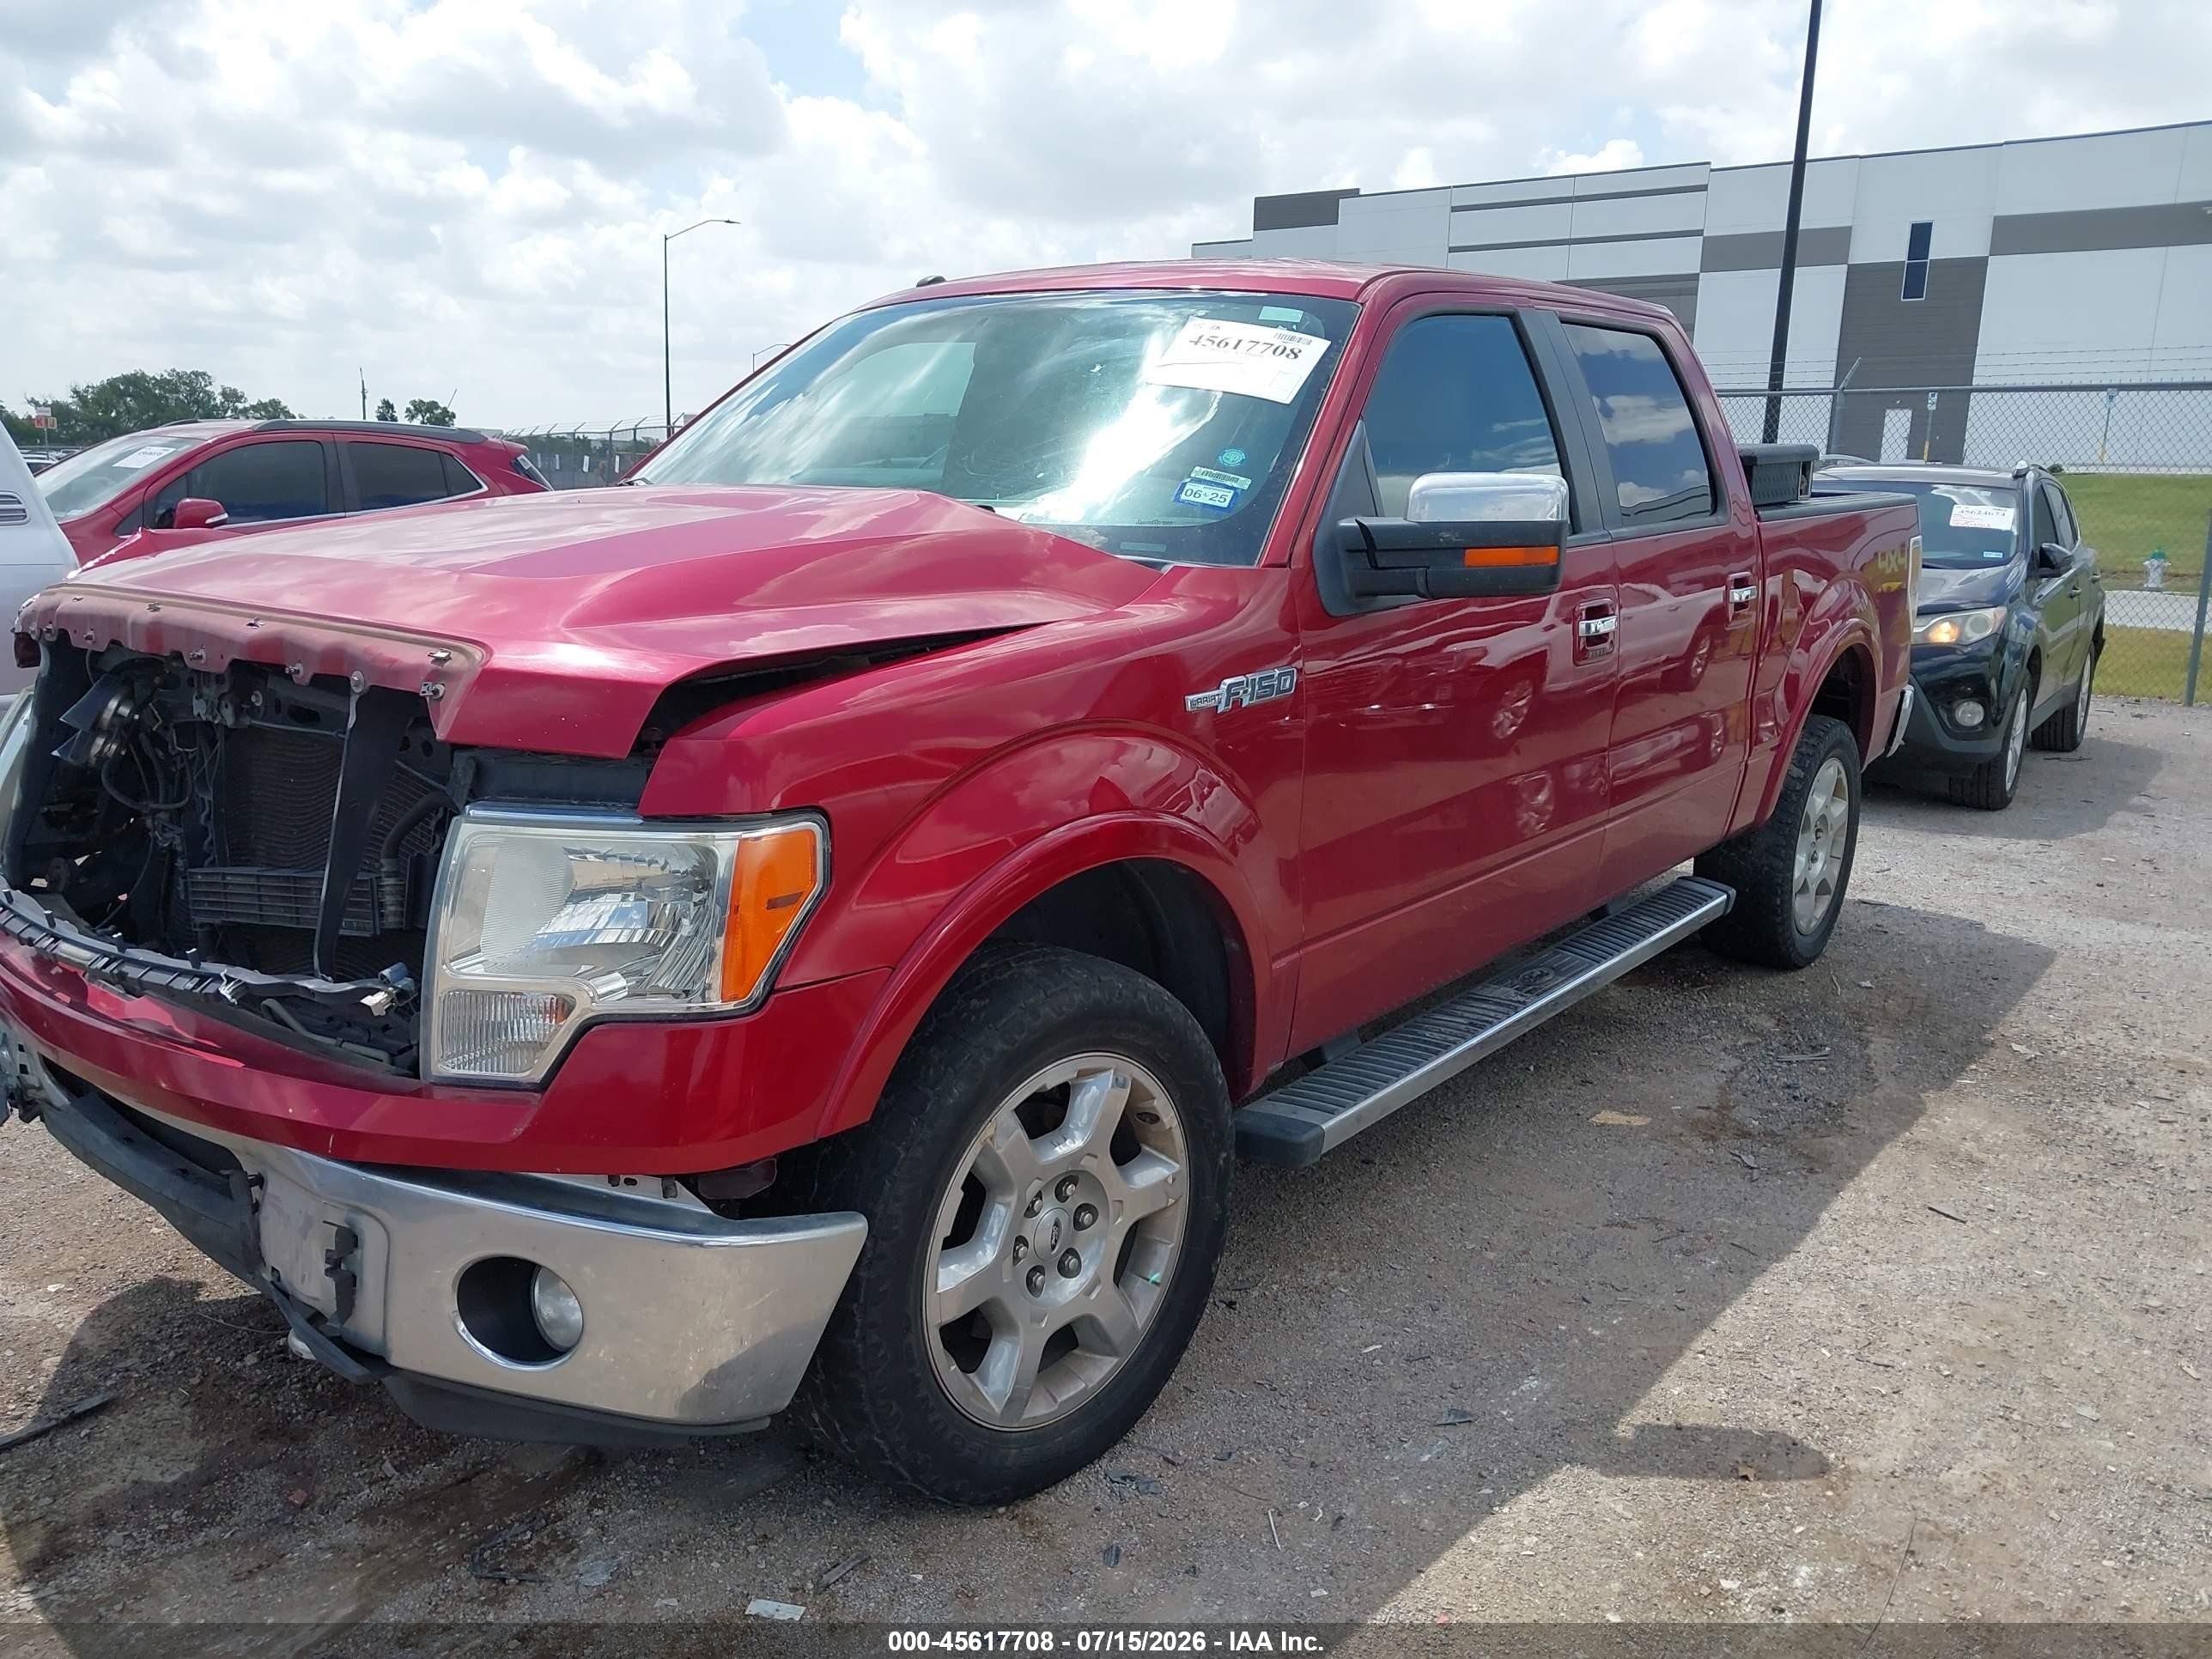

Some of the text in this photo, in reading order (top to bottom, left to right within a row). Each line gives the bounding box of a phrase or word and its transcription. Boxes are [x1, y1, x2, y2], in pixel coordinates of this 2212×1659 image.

[1188, 334, 1302, 360] 45617708
[1184, 488, 1203, 499] 06
[1208, 492, 1229, 504] 25
[1189, 692, 1223, 708] LARIAT
[1218, 668, 1297, 714] F-150
